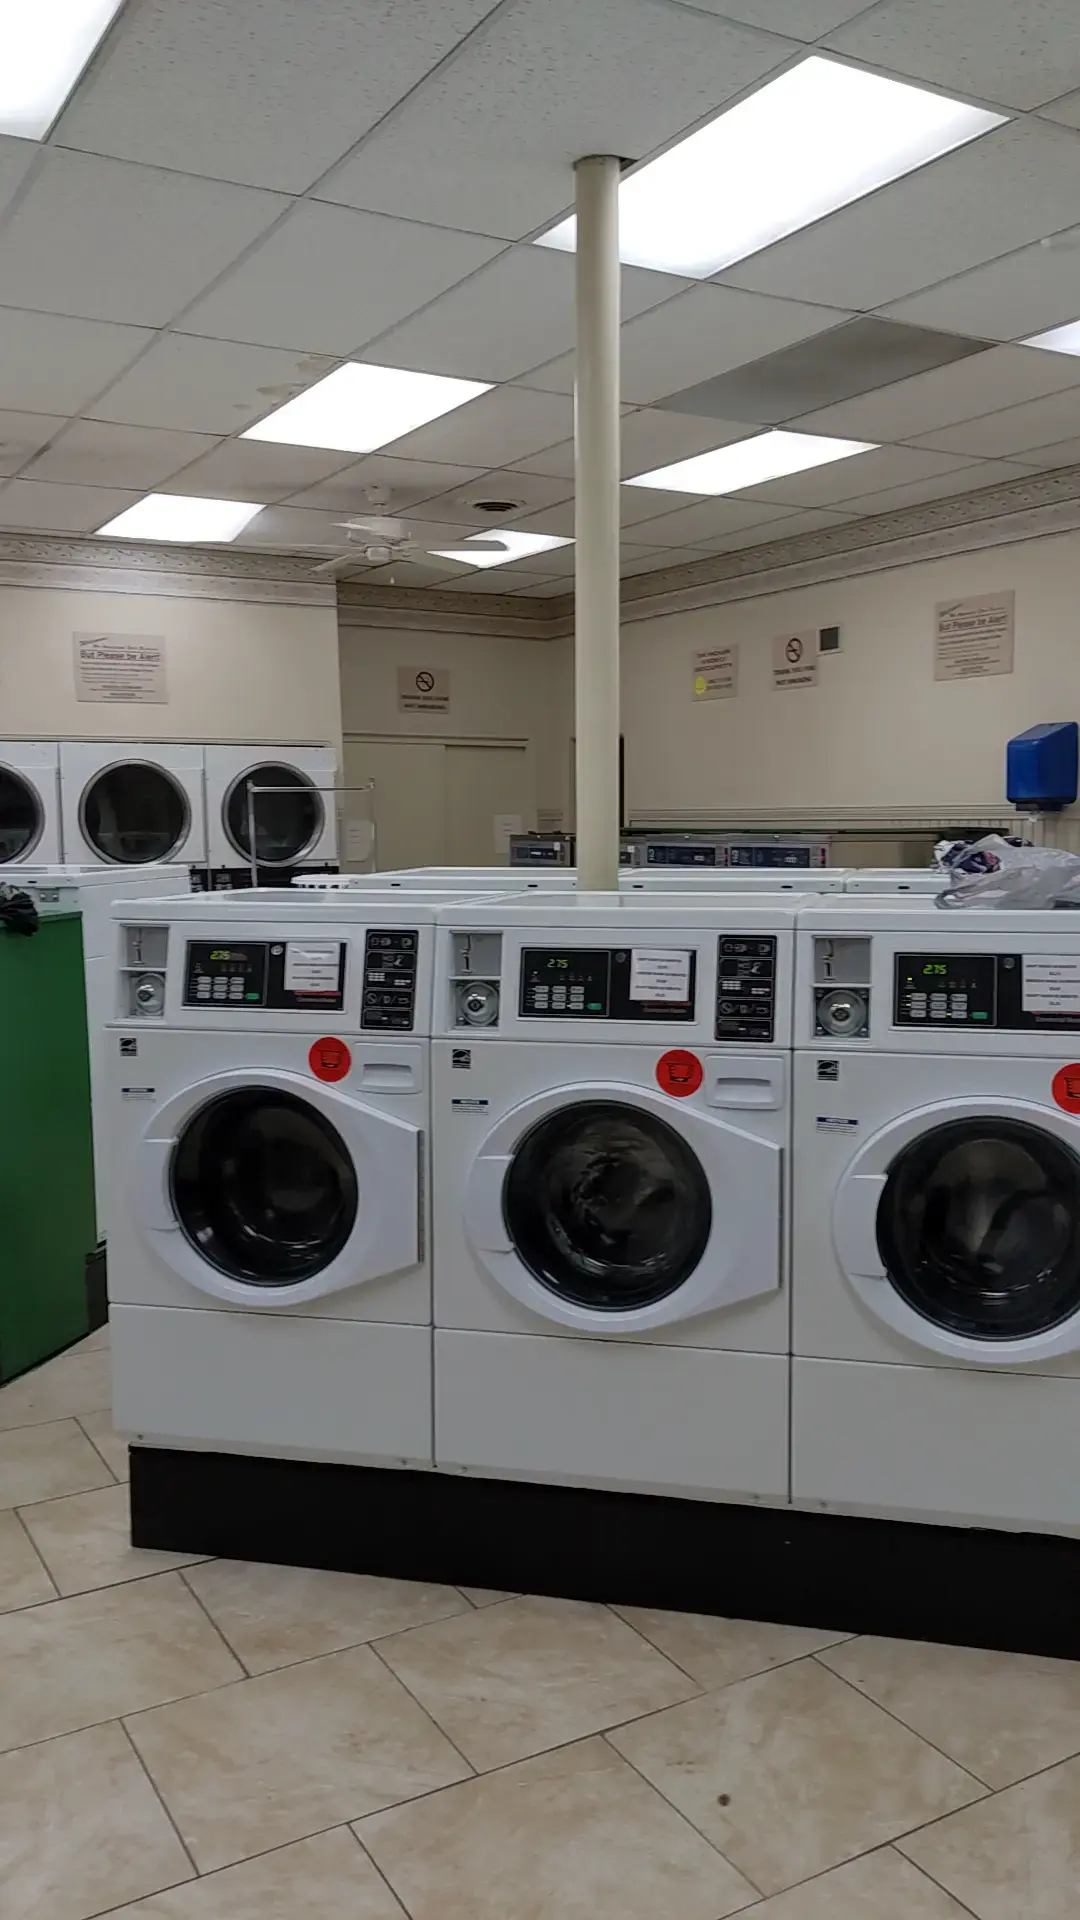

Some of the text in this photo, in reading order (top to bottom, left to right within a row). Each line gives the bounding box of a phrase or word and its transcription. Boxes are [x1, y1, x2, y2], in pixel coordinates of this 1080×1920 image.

[80, 650, 94, 660] But
[97, 651, 124, 660] Please
[547, 958, 568, 969] 275
[923, 964, 947, 975] 275
